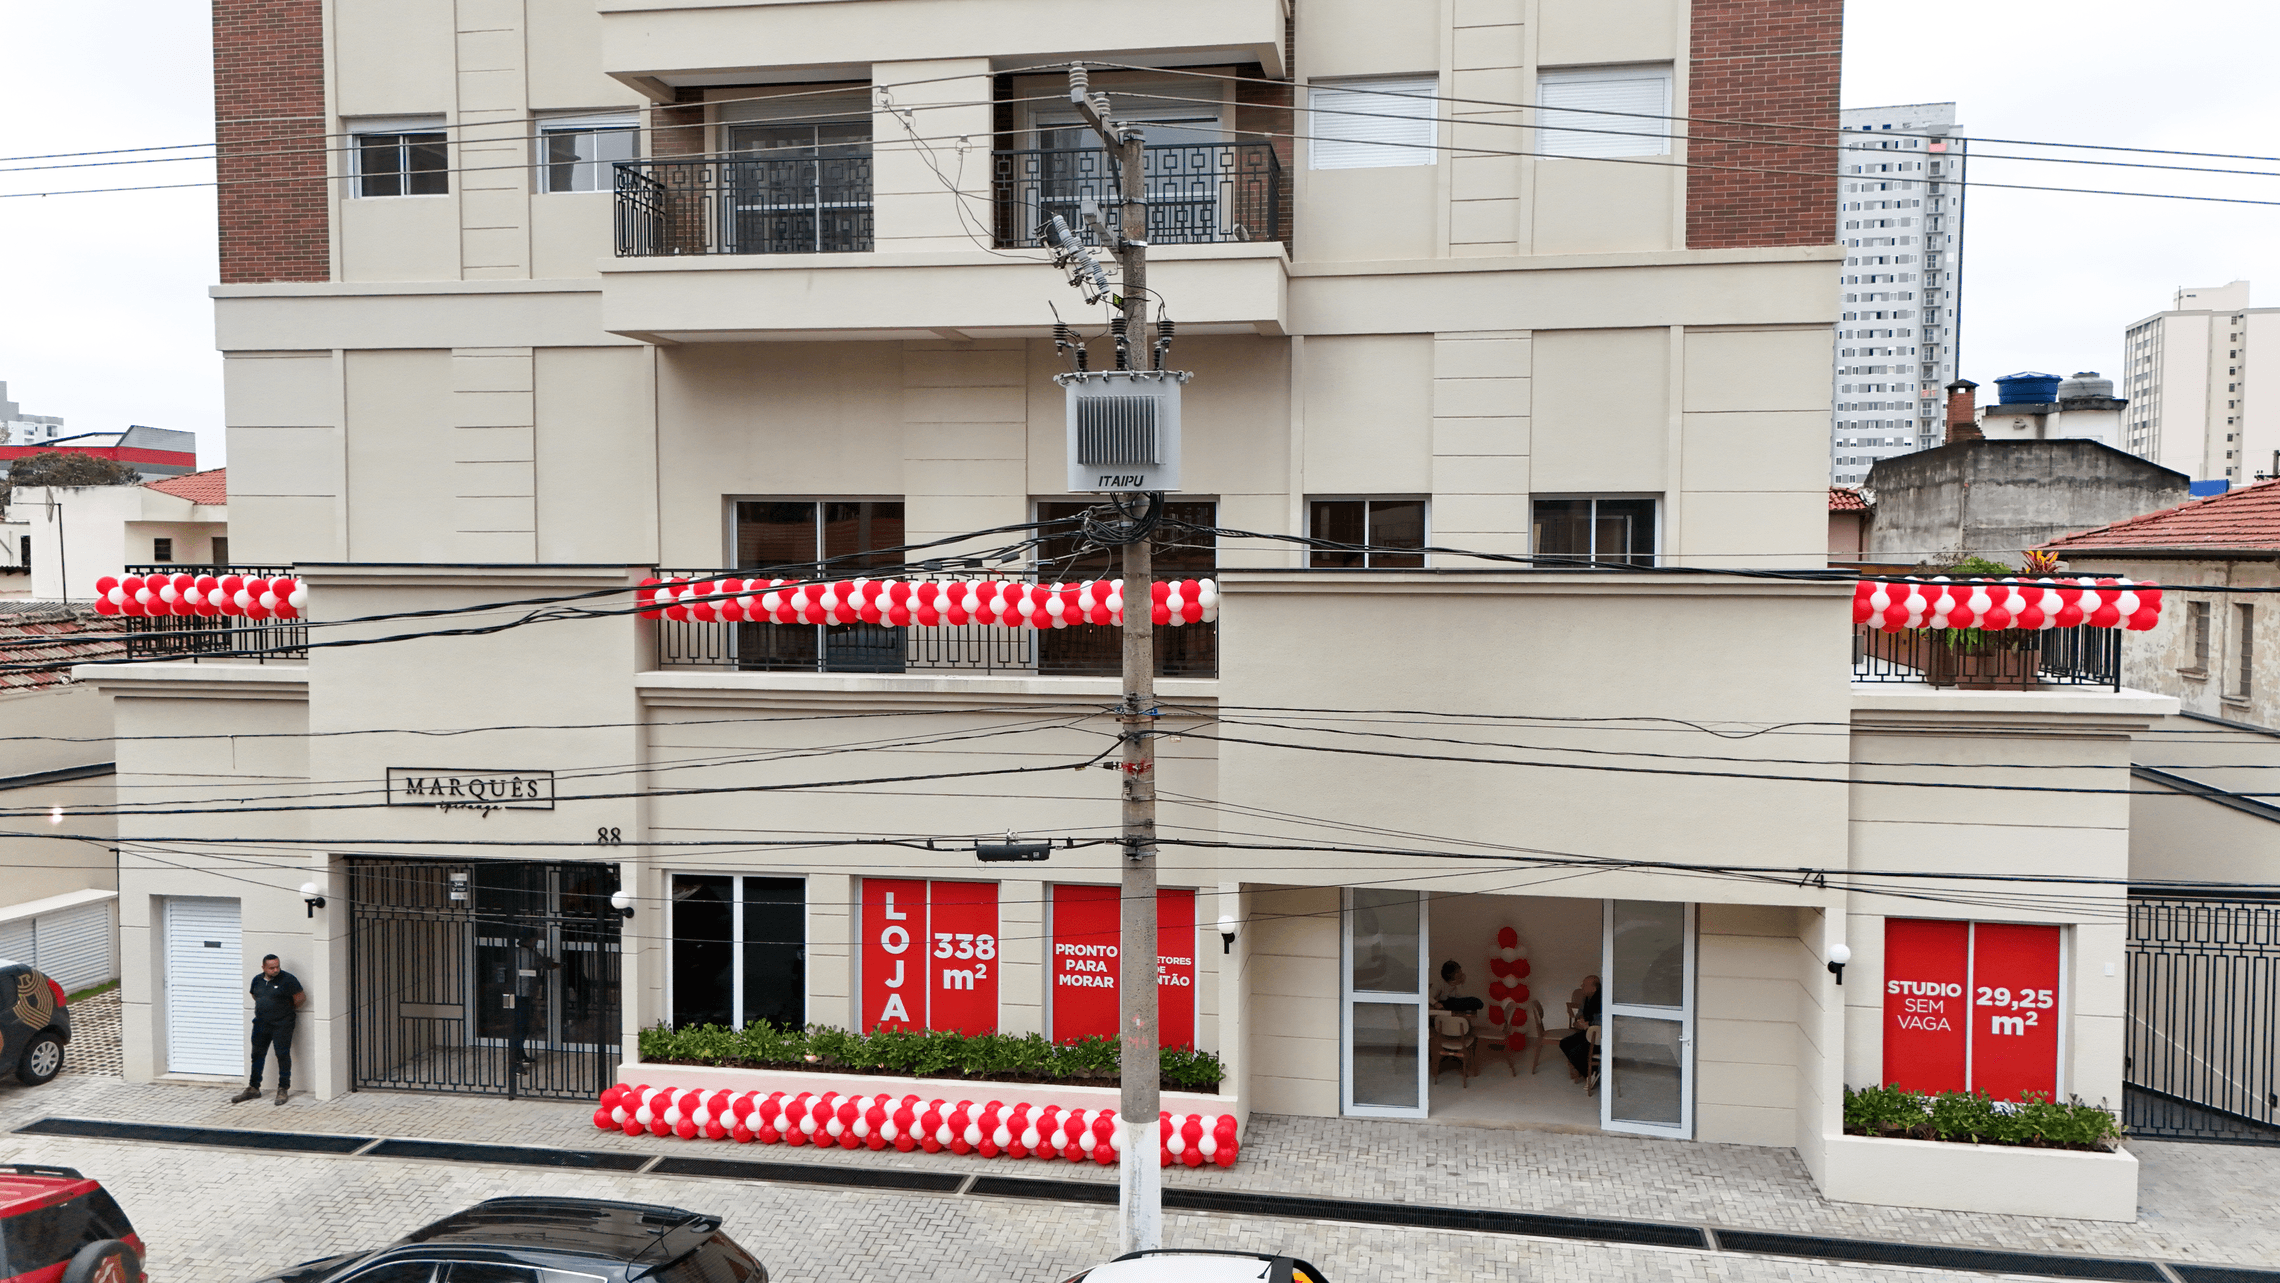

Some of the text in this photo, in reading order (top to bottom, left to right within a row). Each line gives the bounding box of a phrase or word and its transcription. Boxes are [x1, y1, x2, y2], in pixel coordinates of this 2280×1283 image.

[1098, 475, 1144, 487] ITAIPU
[406, 777, 538, 801] MARQUÊS
[597, 826, 622, 846] 88
[1797, 867, 1828, 889] 74
[933, 932, 996, 961] 338
[1055, 943, 1118, 958] PRONTO
[880, 891, 910, 1023] LOJA
[1157, 956, 1192, 966] TORES
[1065, 959, 1108, 973] PARA
[1059, 974, 1114, 989] MORAR
[1887, 980, 1962, 997] STUDIO
[1905, 998, 1944, 1014] SEM
[1976, 986, 2053, 1011] 29,25
[1897, 1015, 1952, 1032] VAGA
